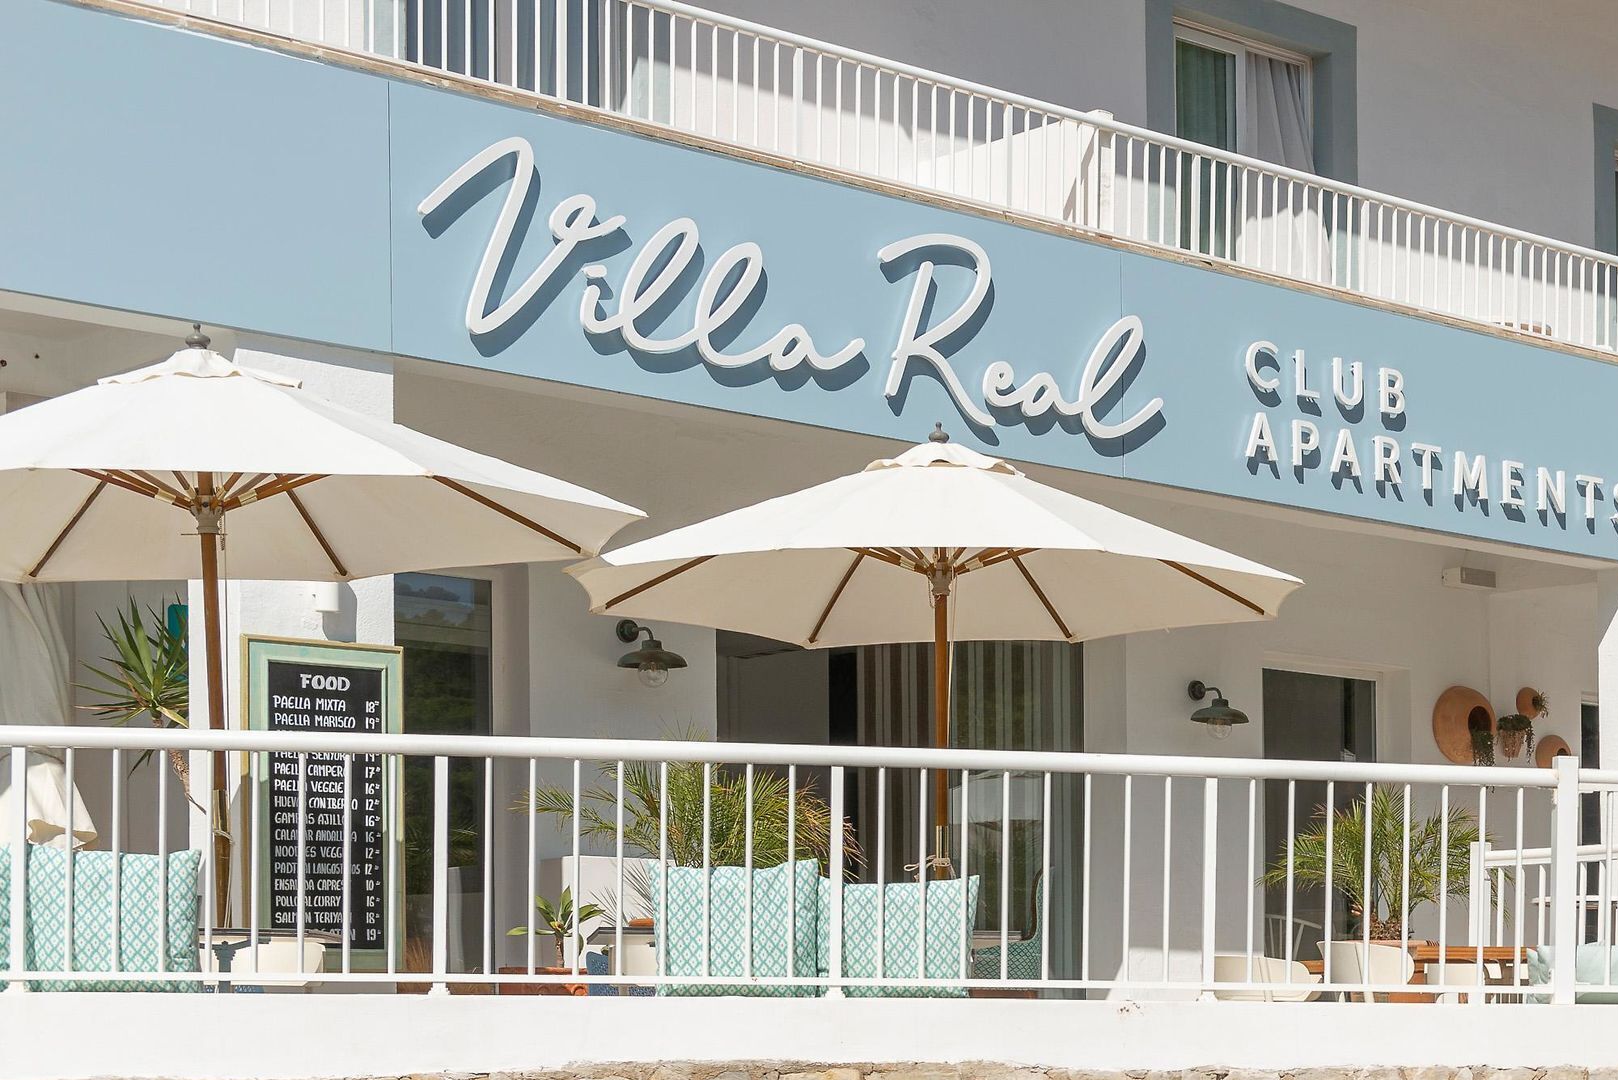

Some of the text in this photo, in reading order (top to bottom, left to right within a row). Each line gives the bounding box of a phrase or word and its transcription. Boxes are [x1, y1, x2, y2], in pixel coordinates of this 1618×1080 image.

[417, 137, 1163, 438] Villa Real
[1245, 340, 1406, 417] CLUB
[300, 674, 351, 691] FOOD
[273, 695, 310, 709] PAELLA
[315, 698, 346, 711] MIXTA
[275, 713, 310, 726] PAELLA
[315, 715, 355, 728] MARISCO
[307, 764, 346, 777] CAMPER
[317, 813, 345, 825] AJILL
[313, 896, 341, 907] CURRY
